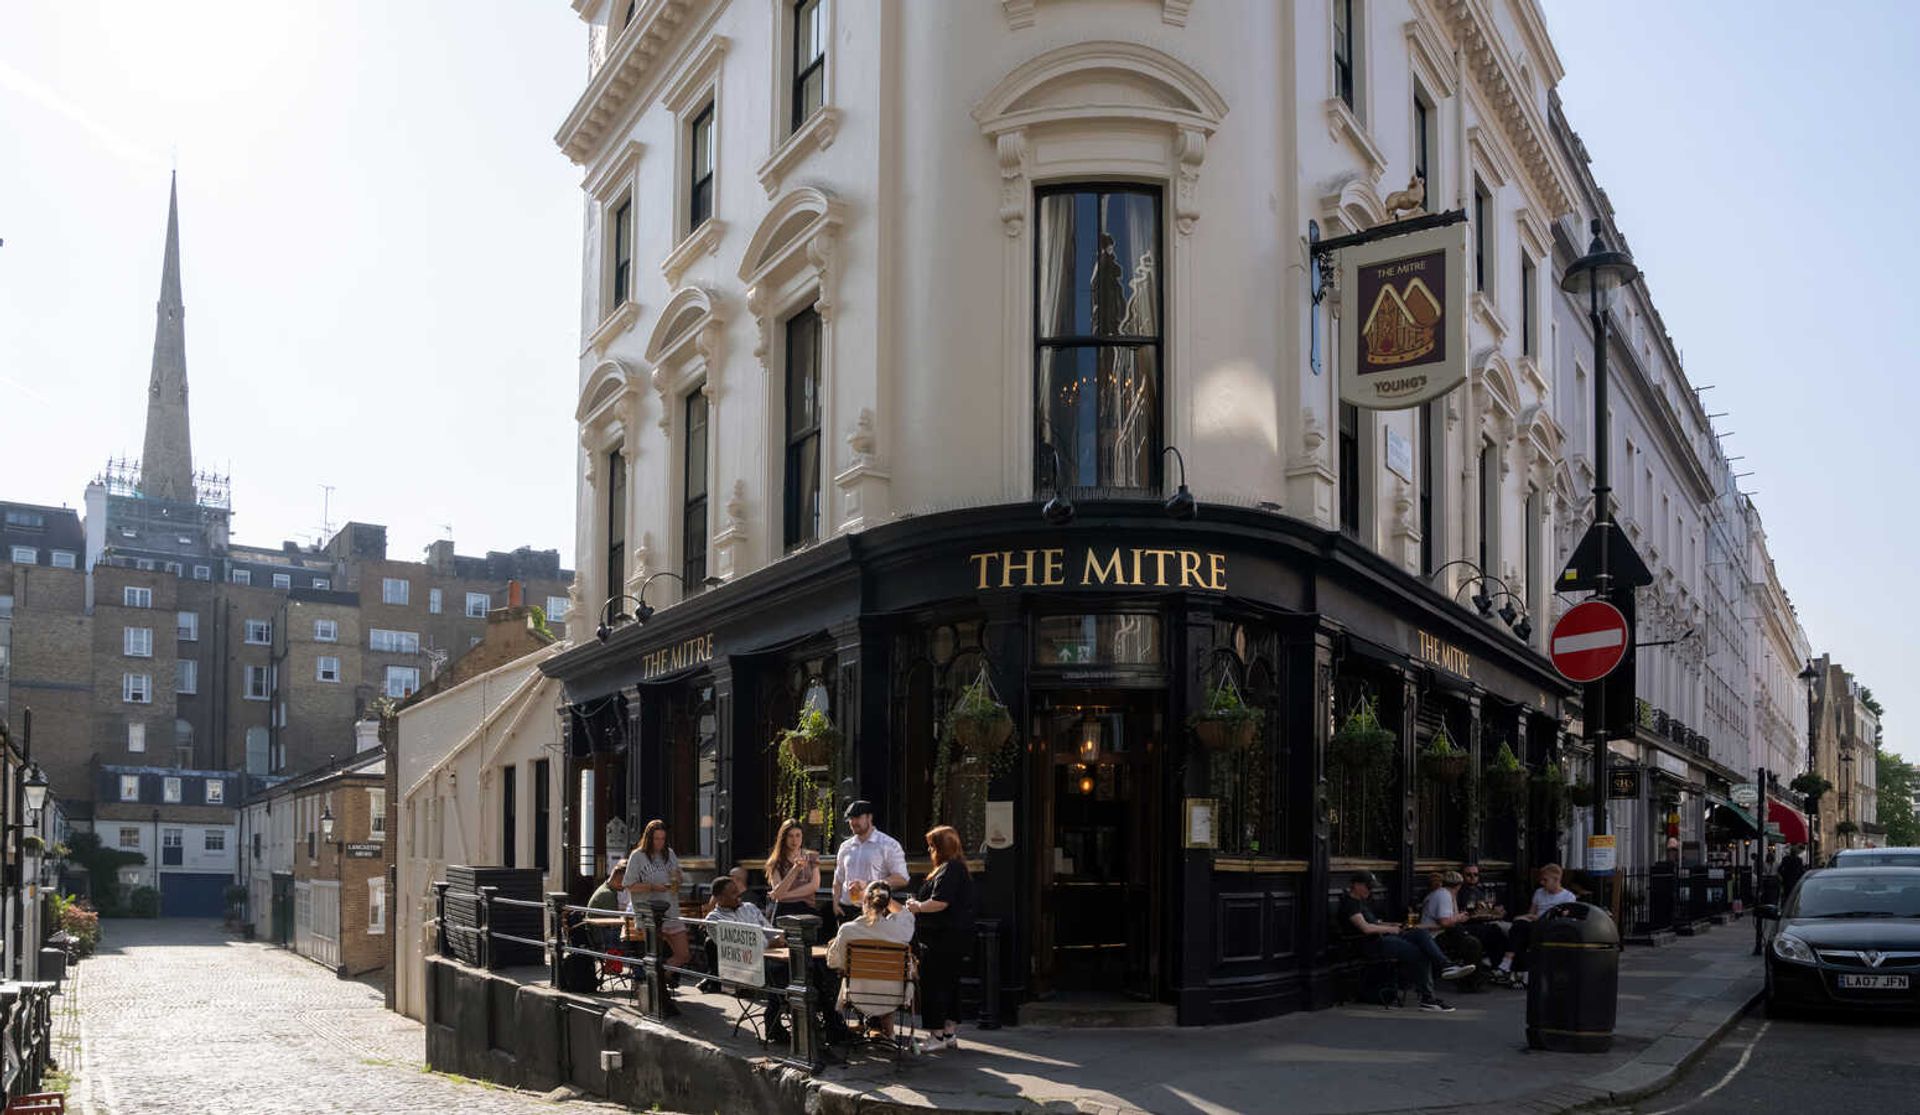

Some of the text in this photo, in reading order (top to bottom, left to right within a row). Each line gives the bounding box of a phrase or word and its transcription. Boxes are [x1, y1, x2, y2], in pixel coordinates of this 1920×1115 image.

[1377, 260, 1426, 279] THE MITRE
[1373, 375, 1428, 394] YOUNG'S
[970, 547, 1227, 590] THE MITRE
[642, 632, 714, 680] THE MITRE
[1418, 629, 1470, 679] THE MITRE
[720, 927, 757, 946] LANCASTER
[720, 945, 741, 962] MEWS
[1883, 976, 1907, 987] JFN
